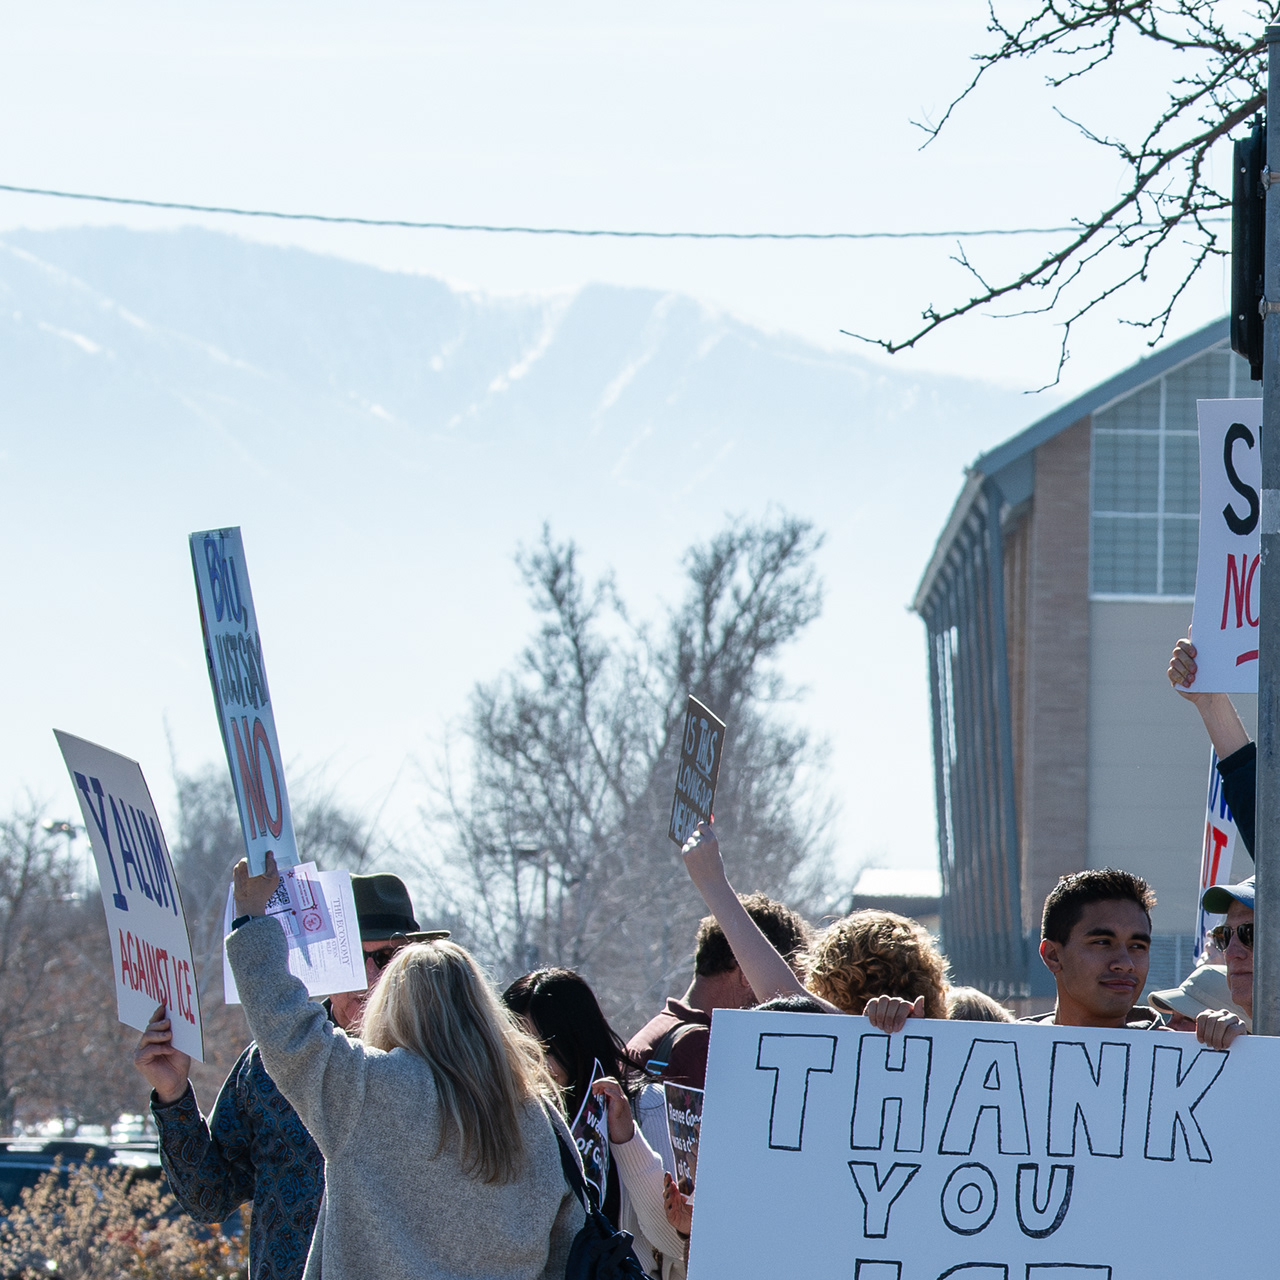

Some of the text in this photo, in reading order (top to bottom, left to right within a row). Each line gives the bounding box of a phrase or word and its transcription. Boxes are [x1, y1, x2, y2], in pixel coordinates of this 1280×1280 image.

[230, 716, 283, 841] NO
[118, 928, 196, 1025] AGAINST ICE
[755, 1033, 1230, 1163] THANK
[847, 1161, 1074, 1239] YOU
